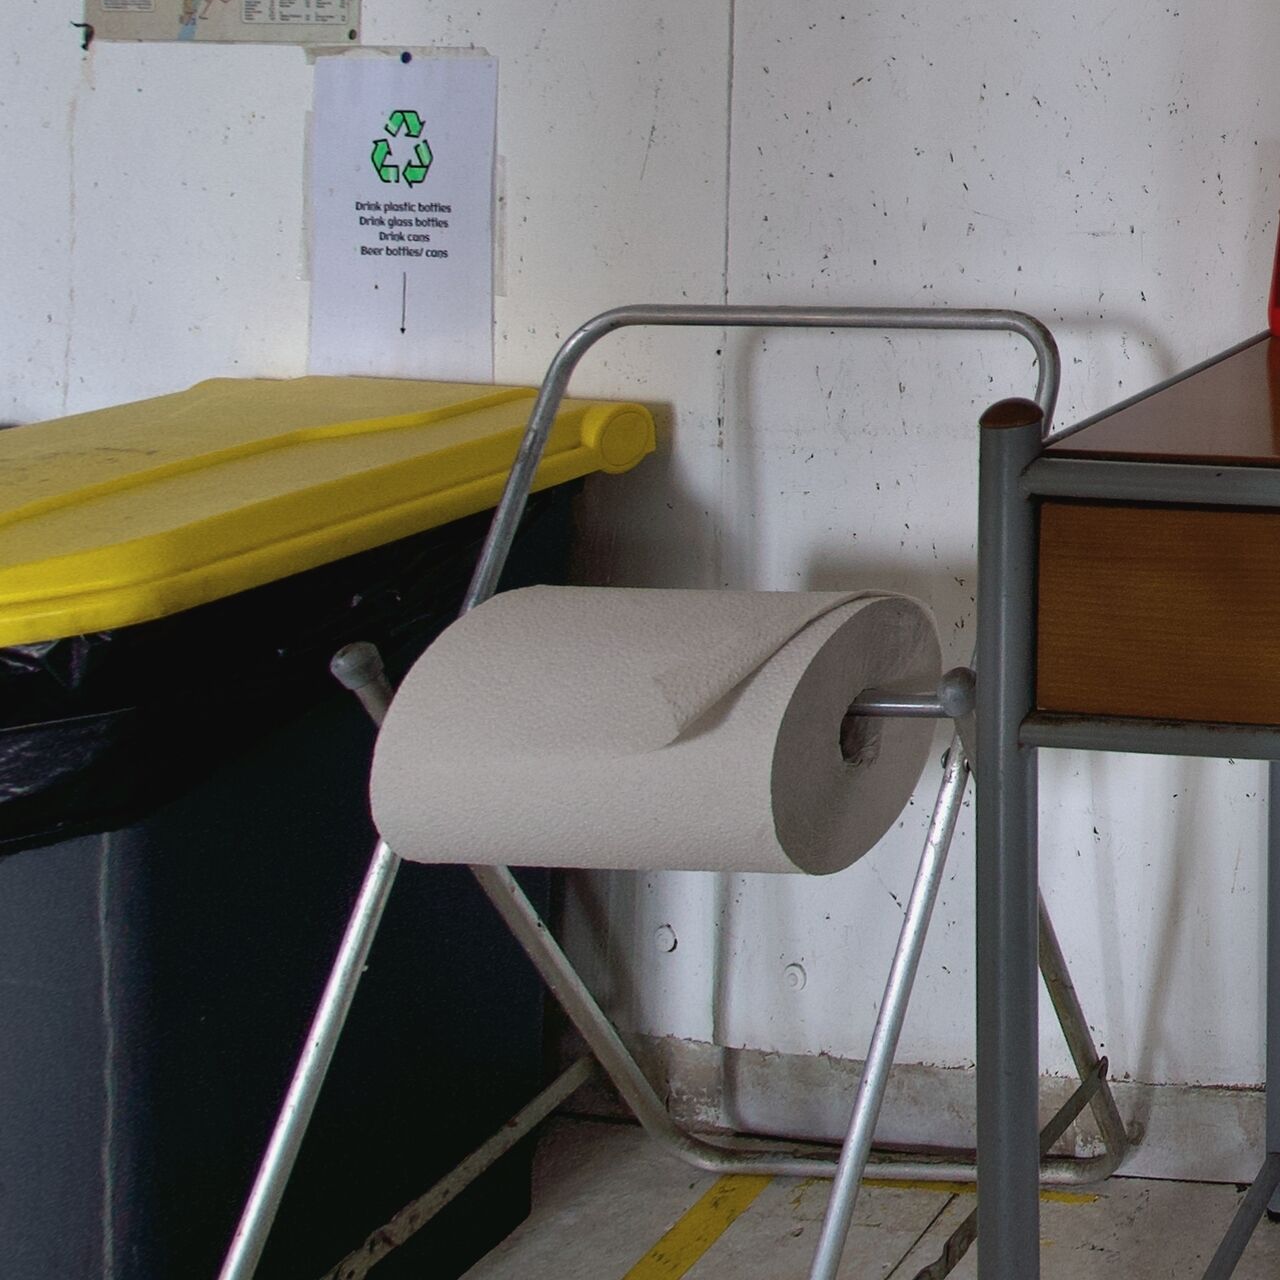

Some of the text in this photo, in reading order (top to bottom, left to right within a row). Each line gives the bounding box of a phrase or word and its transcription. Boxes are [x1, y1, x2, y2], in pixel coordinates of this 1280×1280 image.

[355, 201, 452, 214] Drink plastic bottles
[359, 216, 449, 229] Drink glass bottles
[379, 231, 430, 243] Drink cans
[360, 245, 384, 256] Beer
[426, 249, 449, 259] cans
